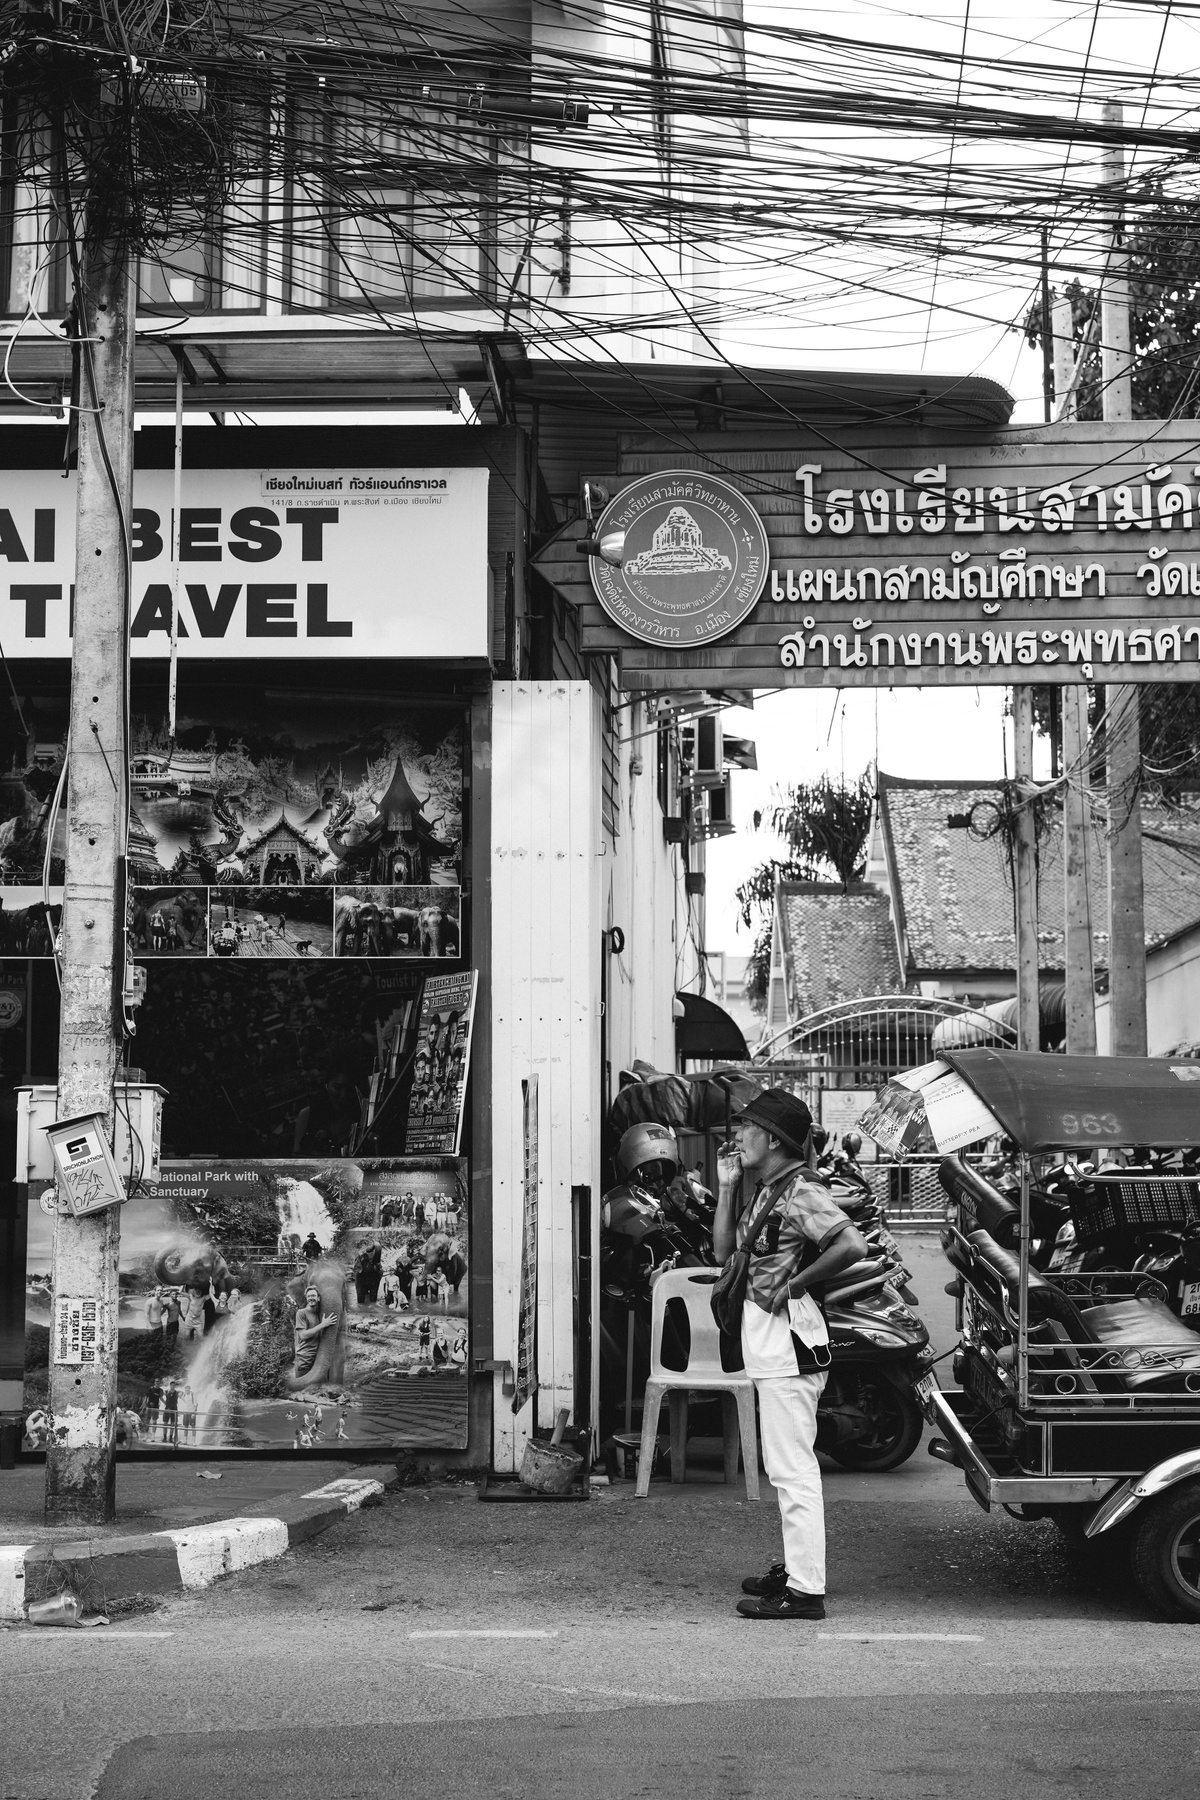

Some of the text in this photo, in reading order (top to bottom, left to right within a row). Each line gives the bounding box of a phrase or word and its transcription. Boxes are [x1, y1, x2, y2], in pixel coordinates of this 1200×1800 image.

[266, 475, 447, 490] เชียงใหม่เบสท์ ทัวร์แอนด์ทราเวล
[384, 496, 409, 505] อ.เมือง
[412, 496, 442, 505] เชียงใหม่
[610, 481, 741, 528] โรงเรียนสามัคคีวิทยาทาน
[796, 463, 1200, 535] โรงเรียนสามัค
[131, 506, 339, 562] BEST
[771, 546, 1105, 614] แผนกสามัญศึกษา
[694, 612, 731, 635] อ.เมือง
[734, 556, 760, 604] เชียงใหม่
[10, 583, 352, 638] TAVEL
[969, 1126, 981, 1134] PEA
[1062, 1113, 1122, 1135] 963
[63, 1154, 104, 1173] SRICHONLATHON
[159, 1171, 259, 1182] ational Park with
[150, 1187, 209, 1198] Sanctuary
